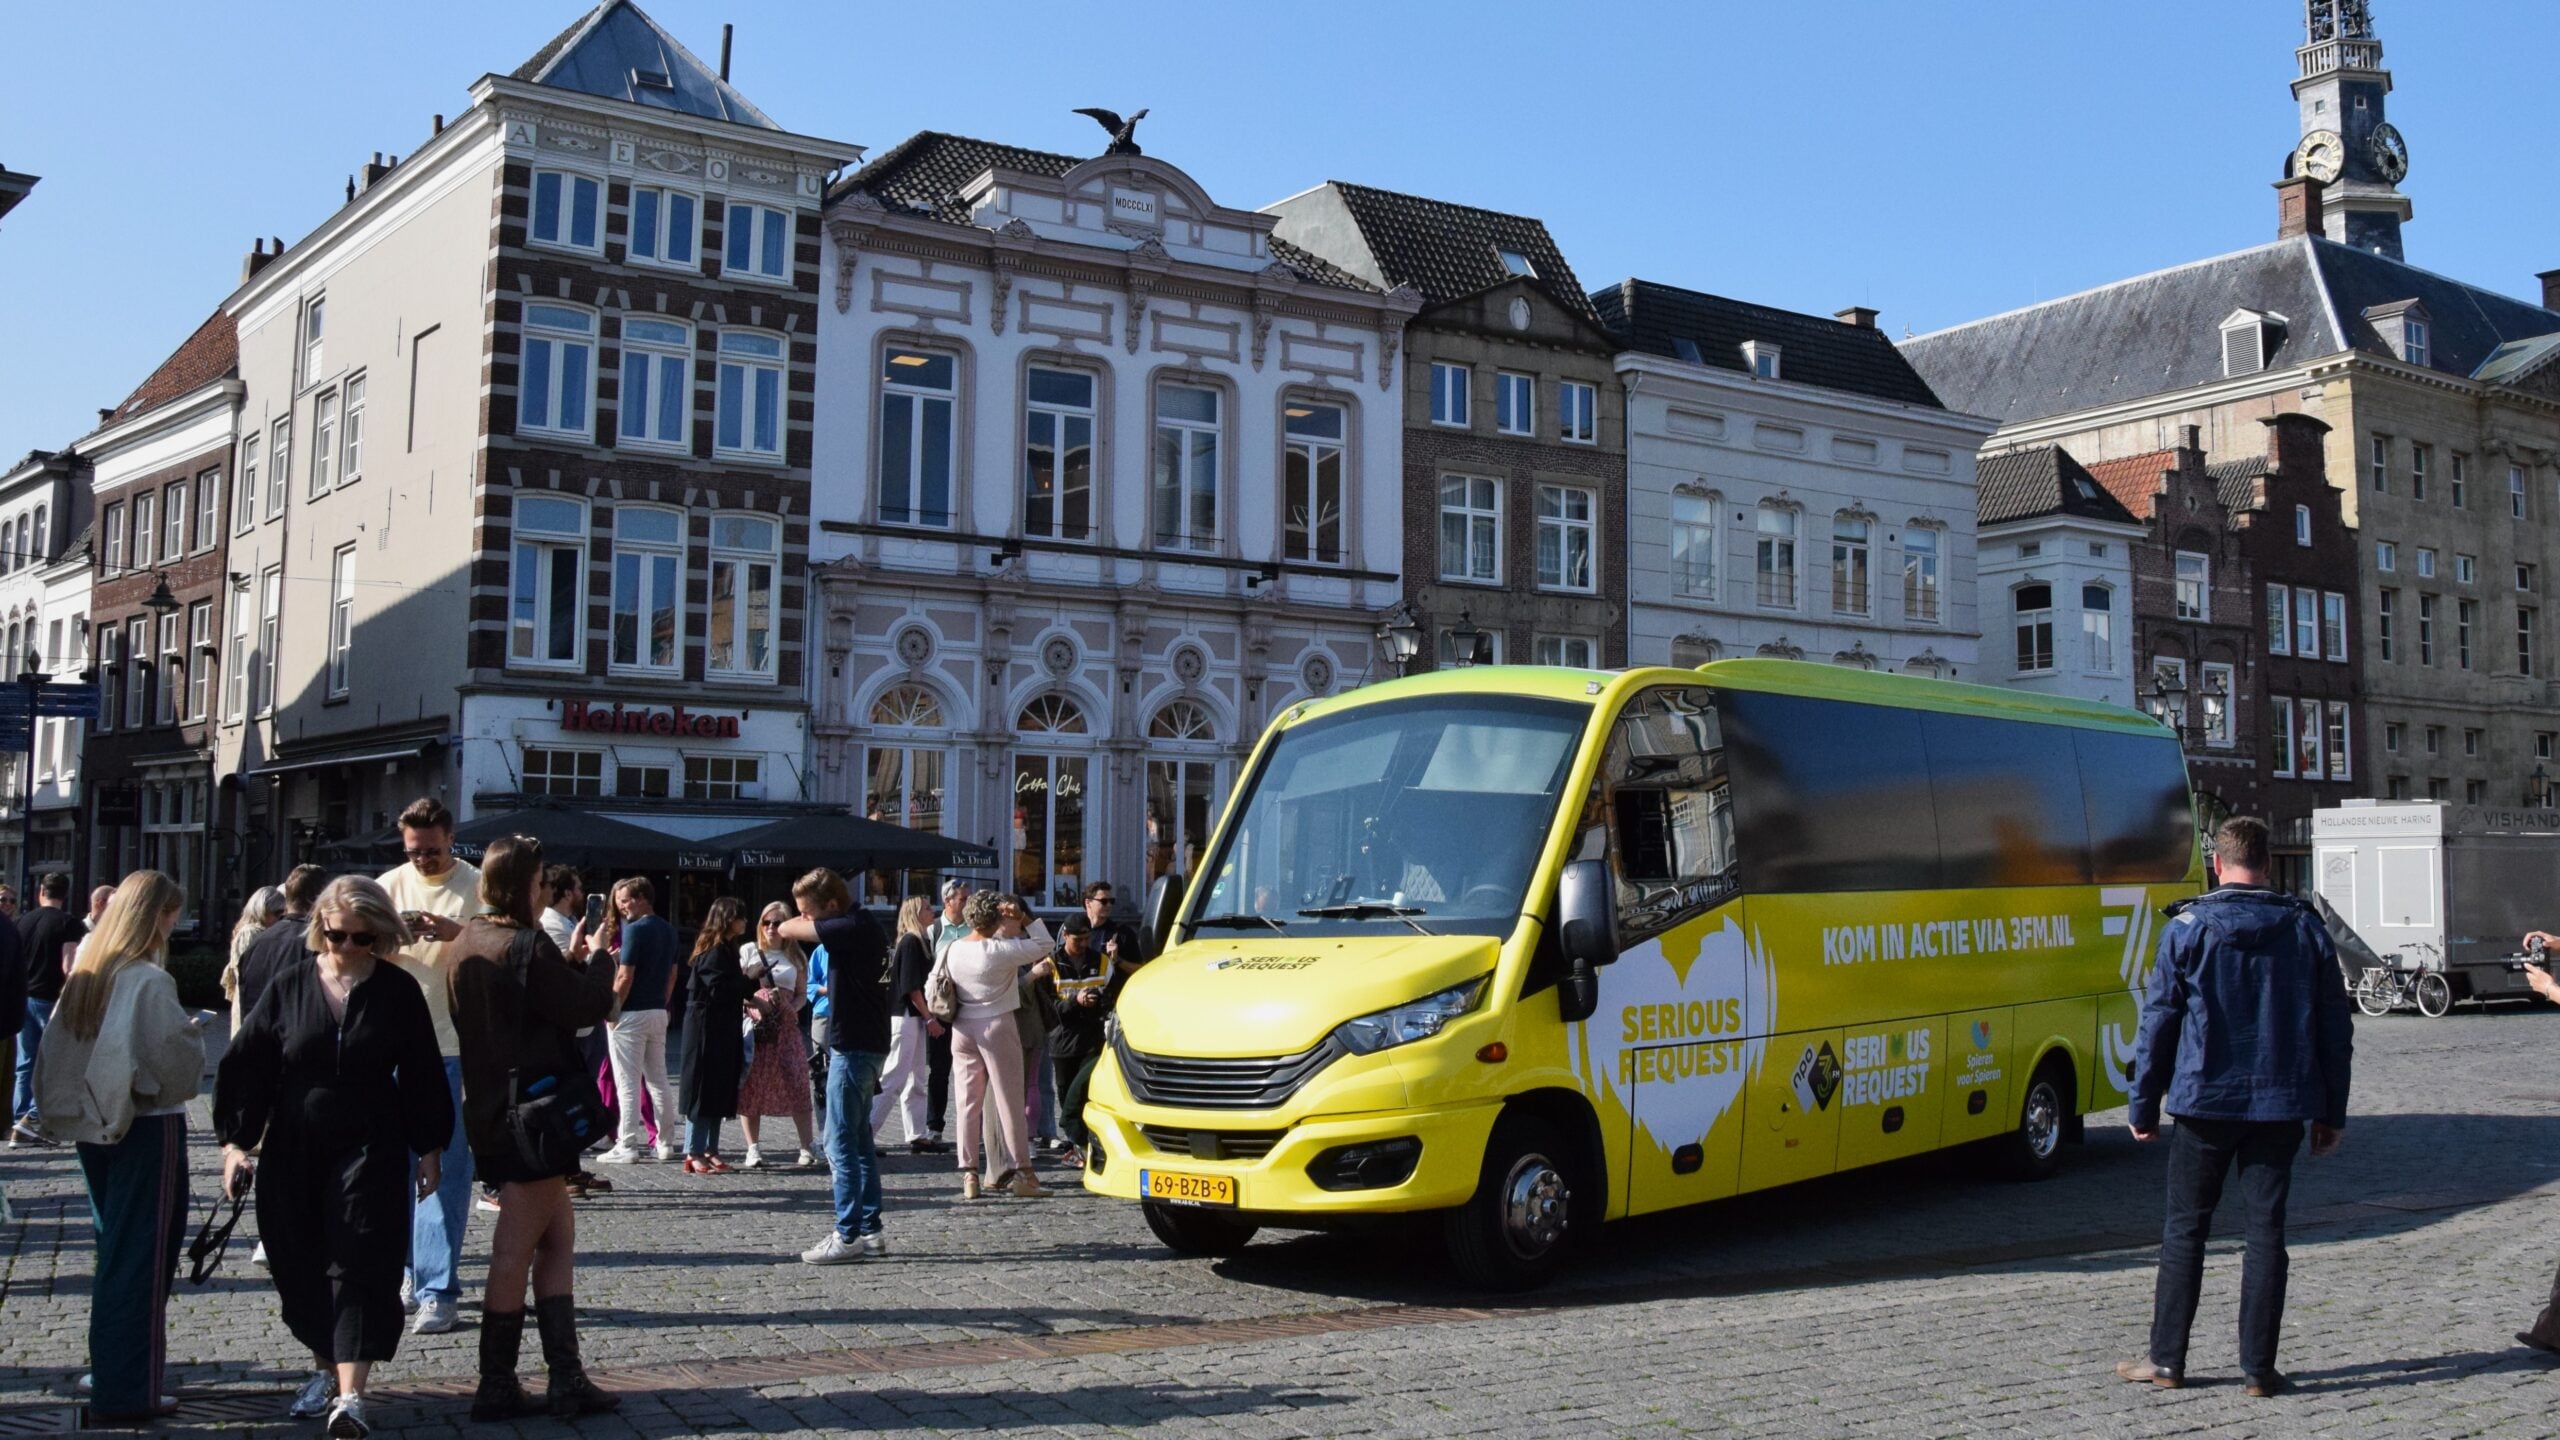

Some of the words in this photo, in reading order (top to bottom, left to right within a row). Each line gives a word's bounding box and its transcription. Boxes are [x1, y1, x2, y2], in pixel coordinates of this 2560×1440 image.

[510, 124, 532, 144] A
[616, 144, 630, 163] E
[710, 161, 725, 179] O
[805, 176, 819, 195] U
[1115, 197, 1153, 213] MDCCCLXI
[560, 699, 741, 738] Heineken
[1056, 774, 1081, 797] Club
[2320, 816, 2367, 827] HOLLANDSE
[2368, 815, 2398, 825] NIEUWE
[2401, 814, 2432, 825] HARING
[678, 855, 694, 867] De
[742, 853, 758, 864] De
[952, 855, 966, 865] De
[1822, 925, 1876, 966] KOM
[1881, 923, 1905, 961] IN
[1910, 919, 1970, 959] ACTIE
[1973, 917, 2008, 953] VIA
[2010, 914, 2075, 950] 3FM.NL
[1621, 998, 1742, 1043] SERIOUS
[1618, 1042, 1745, 1085] REQUEST
[1793, 1048, 1813, 1089] npo
[1967, 1054, 1994, 1070] Spieren
[1842, 1063, 1930, 1107] REQUEST
[1956, 1073, 1973, 1086] voor
[1974, 1068, 2001, 1085] Spieren
[1154, 1176, 1227, 1199] 69-BZB-9
